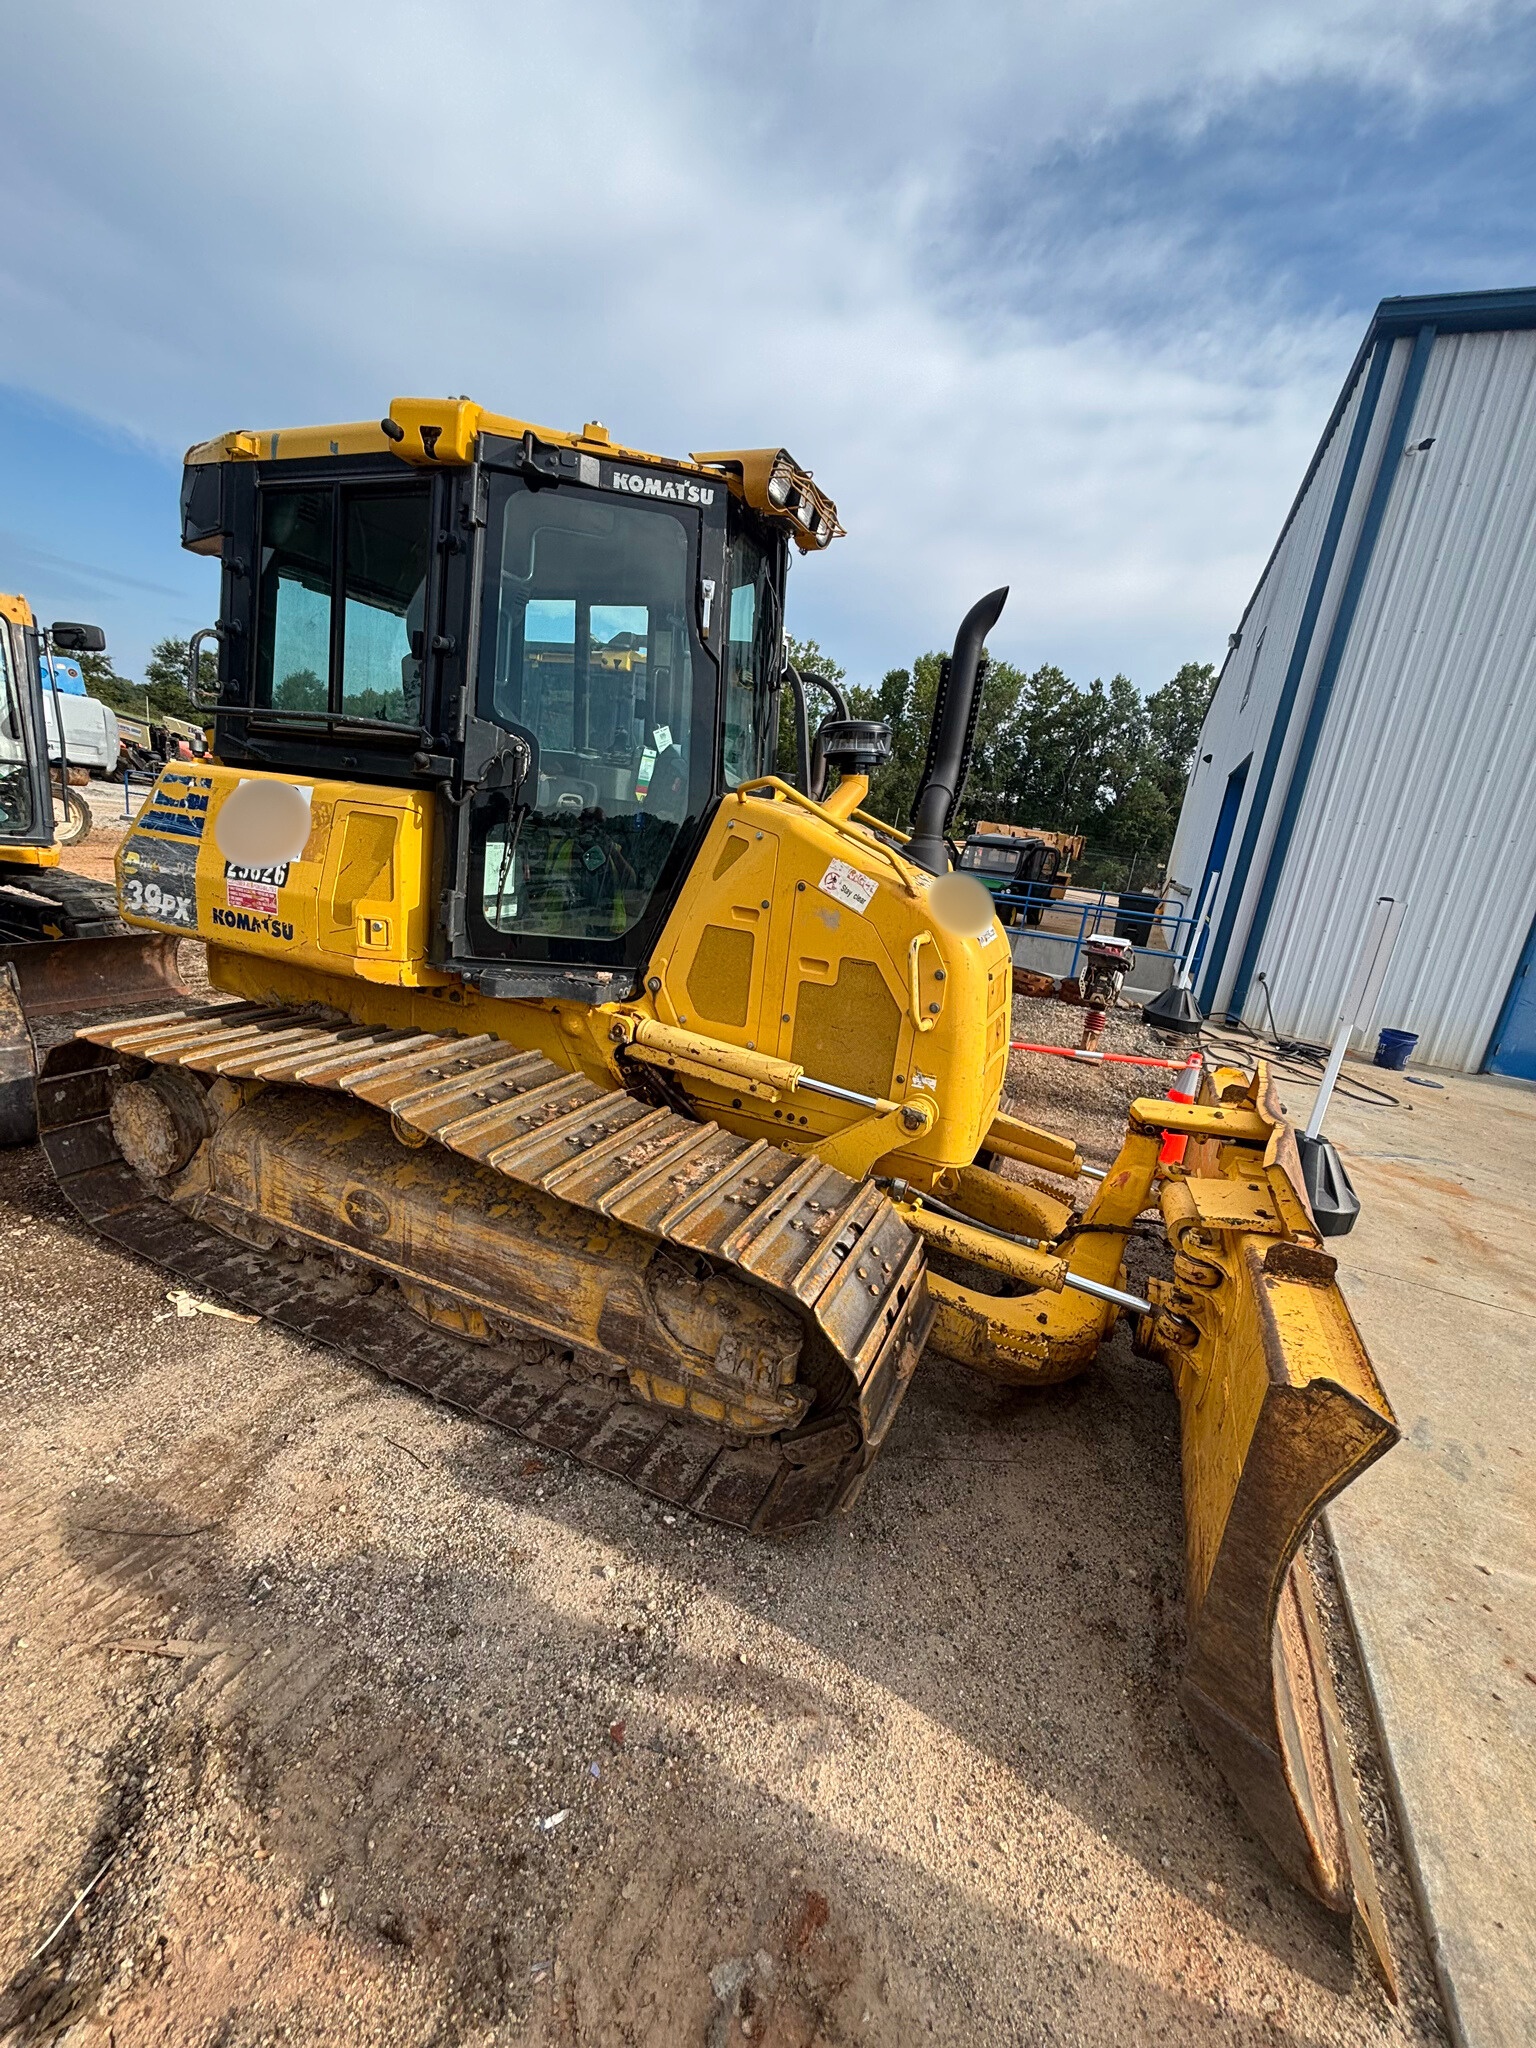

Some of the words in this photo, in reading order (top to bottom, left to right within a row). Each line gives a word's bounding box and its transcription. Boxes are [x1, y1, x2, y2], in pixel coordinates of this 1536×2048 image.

[613, 472, 714, 505] KOMATSU
[840, 884, 852, 898] Stay
[853, 893, 866, 905] clear
[212, 908, 294, 941] KOMATSU
